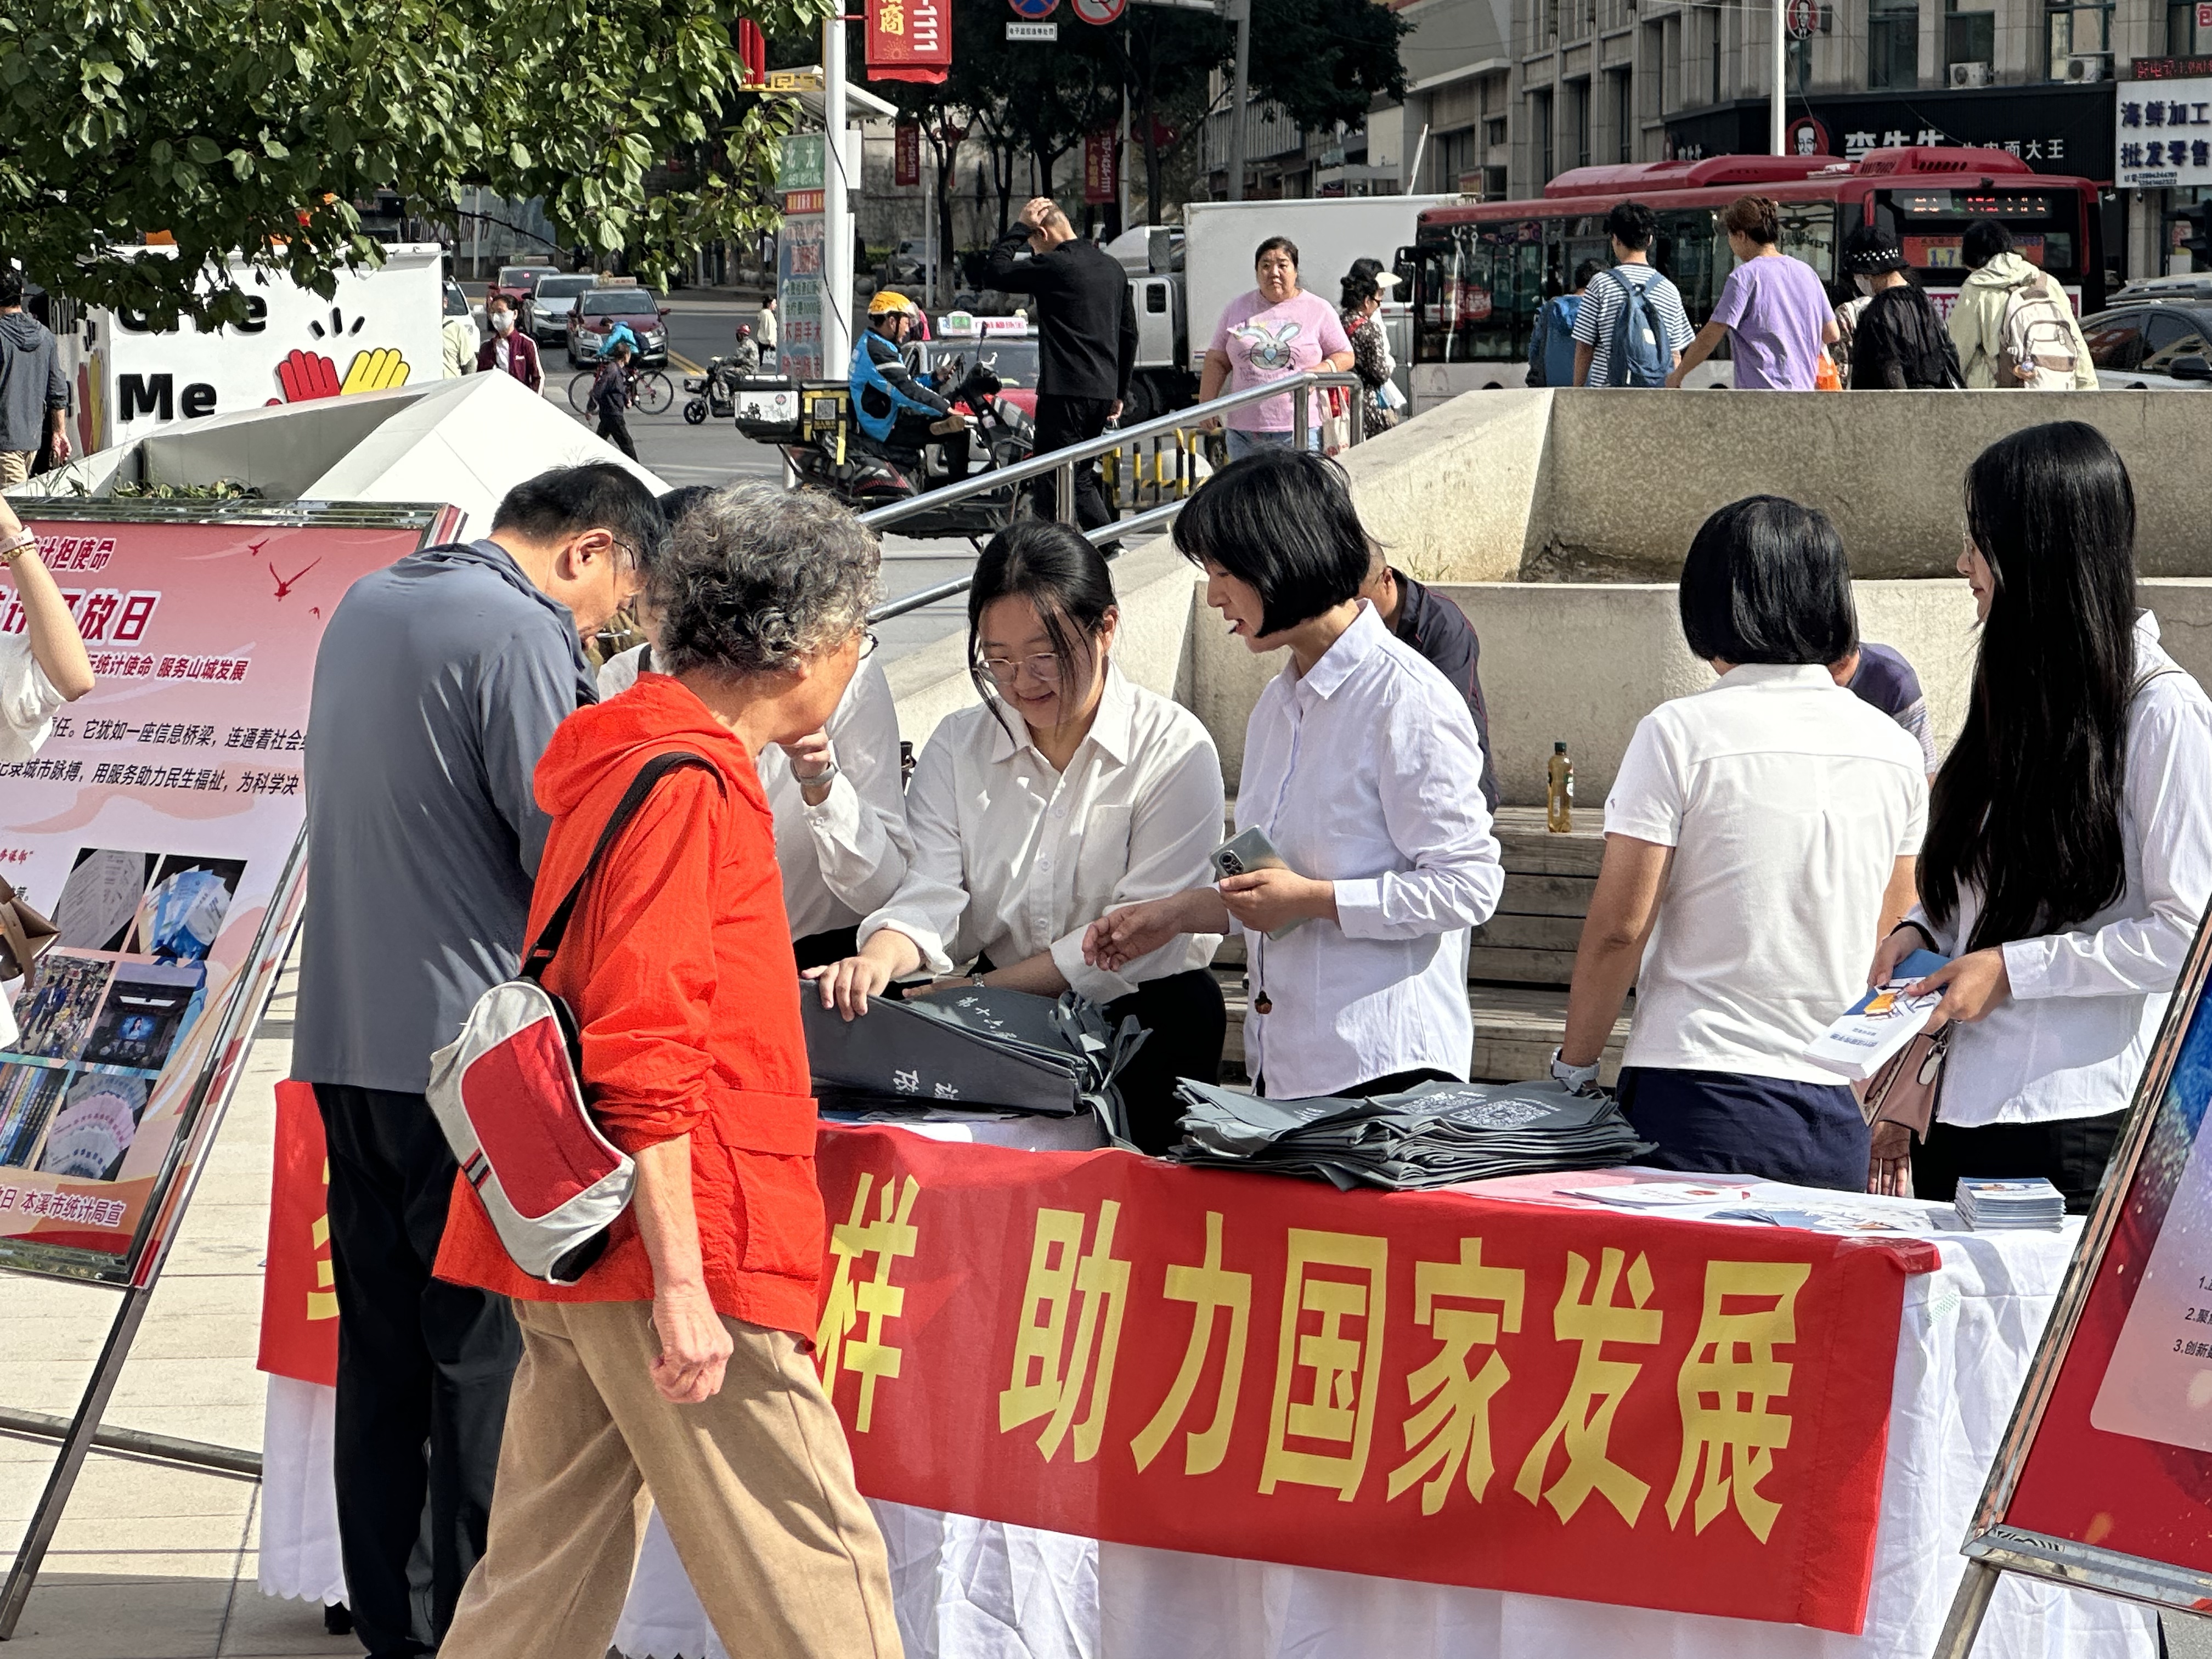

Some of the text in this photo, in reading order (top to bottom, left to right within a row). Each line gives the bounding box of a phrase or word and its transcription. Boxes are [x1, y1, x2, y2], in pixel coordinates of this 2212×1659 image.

[2121, 100, 2210, 127] 海鲜加工
[2121, 139, 2209, 167] 批发零售
[119, 374, 216, 421] Me
[35, 538, 115, 570] 计担使命
[156, 657, 249, 681] 服务山城发展
[20, 1190, 125, 1224] 本溪市统计局宣
[2199, 1276, 2212, 1291] 1.
[816, 1172, 1812, 1545] 样 助力国家发展
